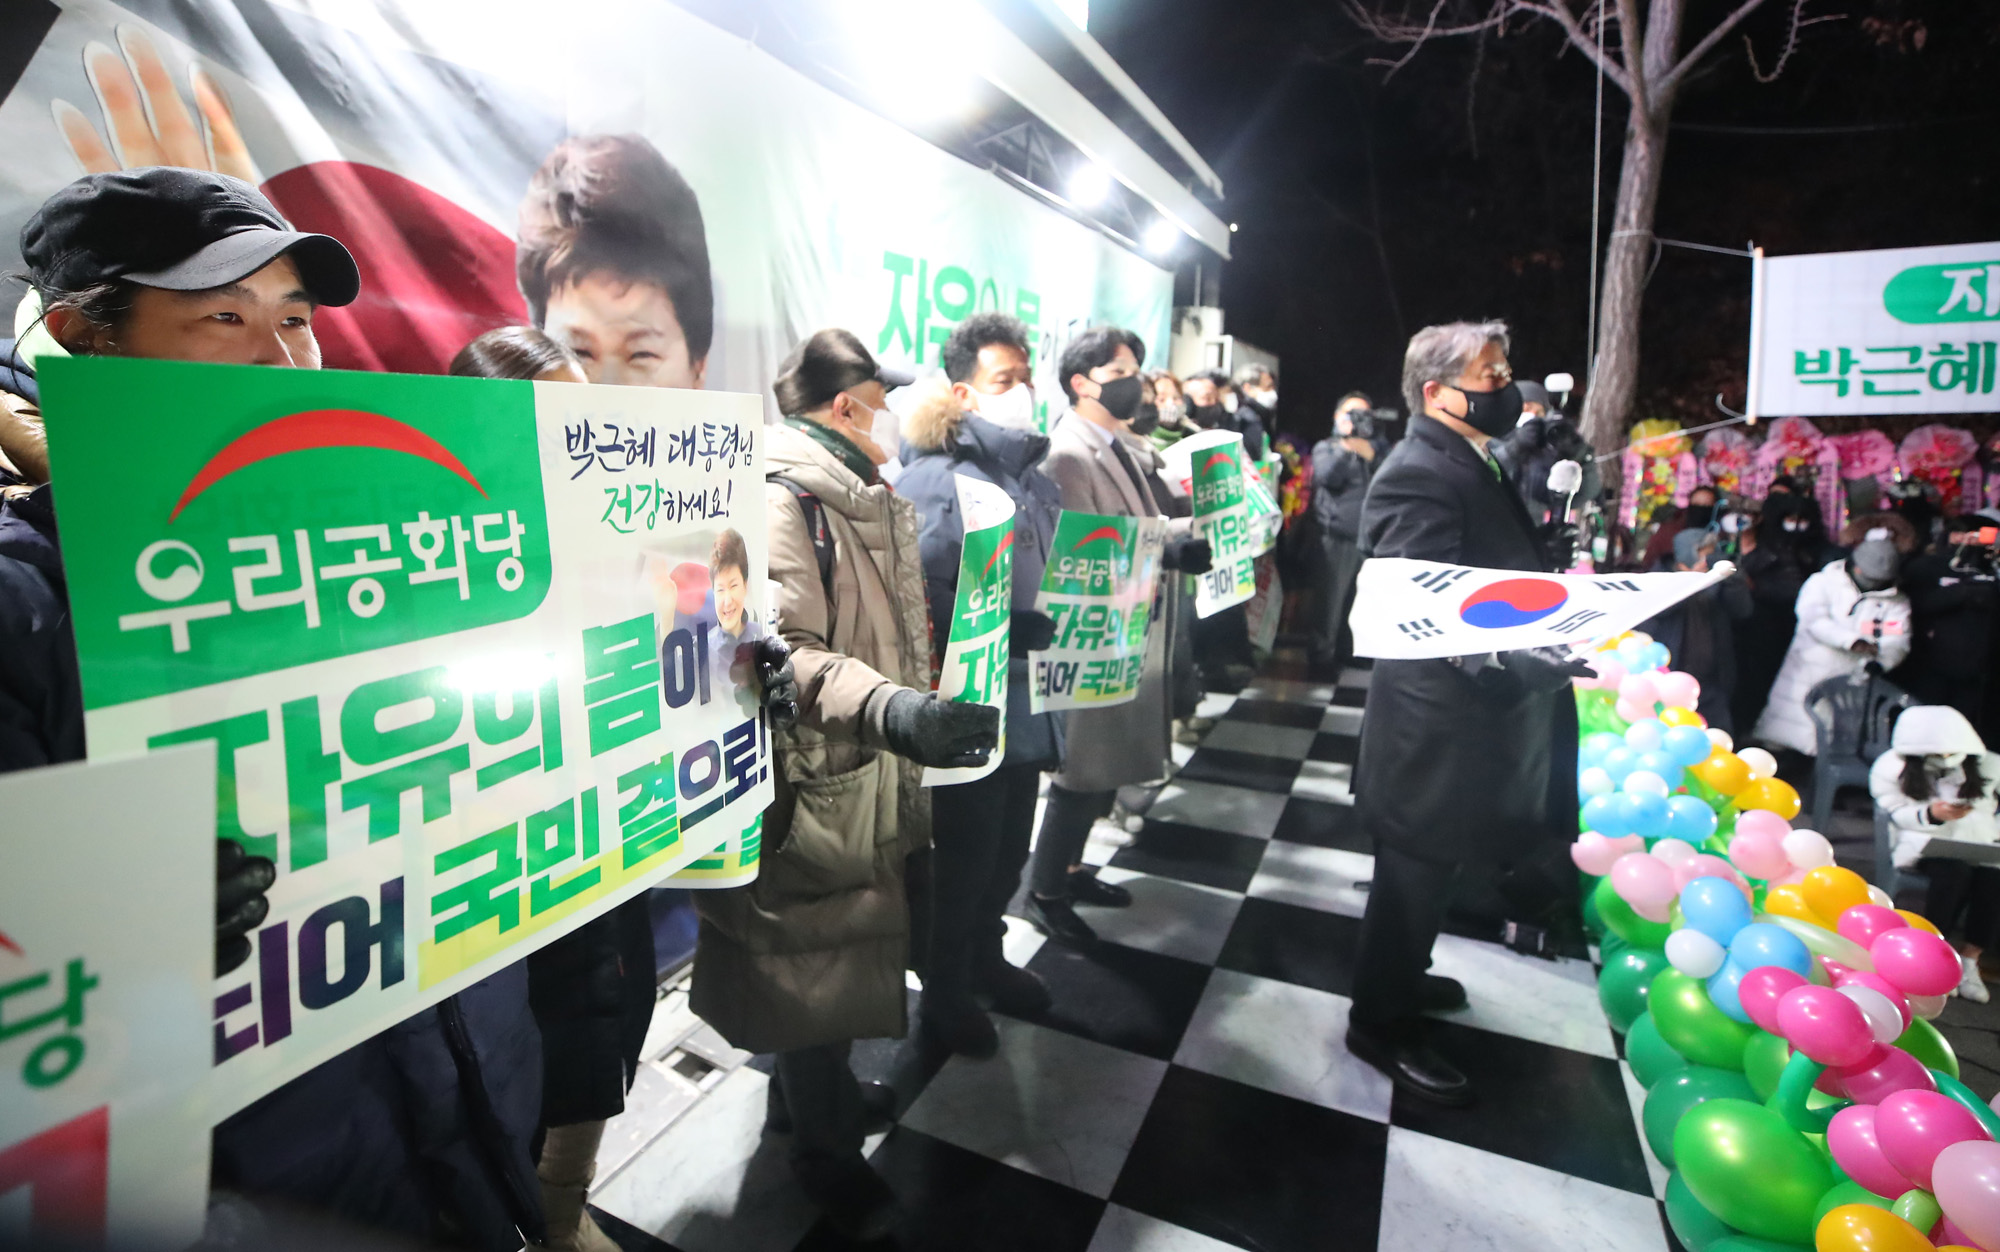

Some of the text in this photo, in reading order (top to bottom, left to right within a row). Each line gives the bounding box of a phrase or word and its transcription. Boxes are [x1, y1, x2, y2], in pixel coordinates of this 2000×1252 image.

[1794, 342, 1997, 397] 박근혜
[564, 418, 754, 480] 박근혜 대통령님
[600, 477, 733, 534] 건강하세요!
[118, 508, 526, 653] 우리공화당
[1046, 602, 1126, 651] 자유의
[1035, 660, 1080, 698] 되어
[1080, 657, 1126, 697] 국민
[147, 612, 712, 872] 자유의 몸이
[431, 785, 601, 945] 국민
[616, 705, 768, 871] 결으로!
